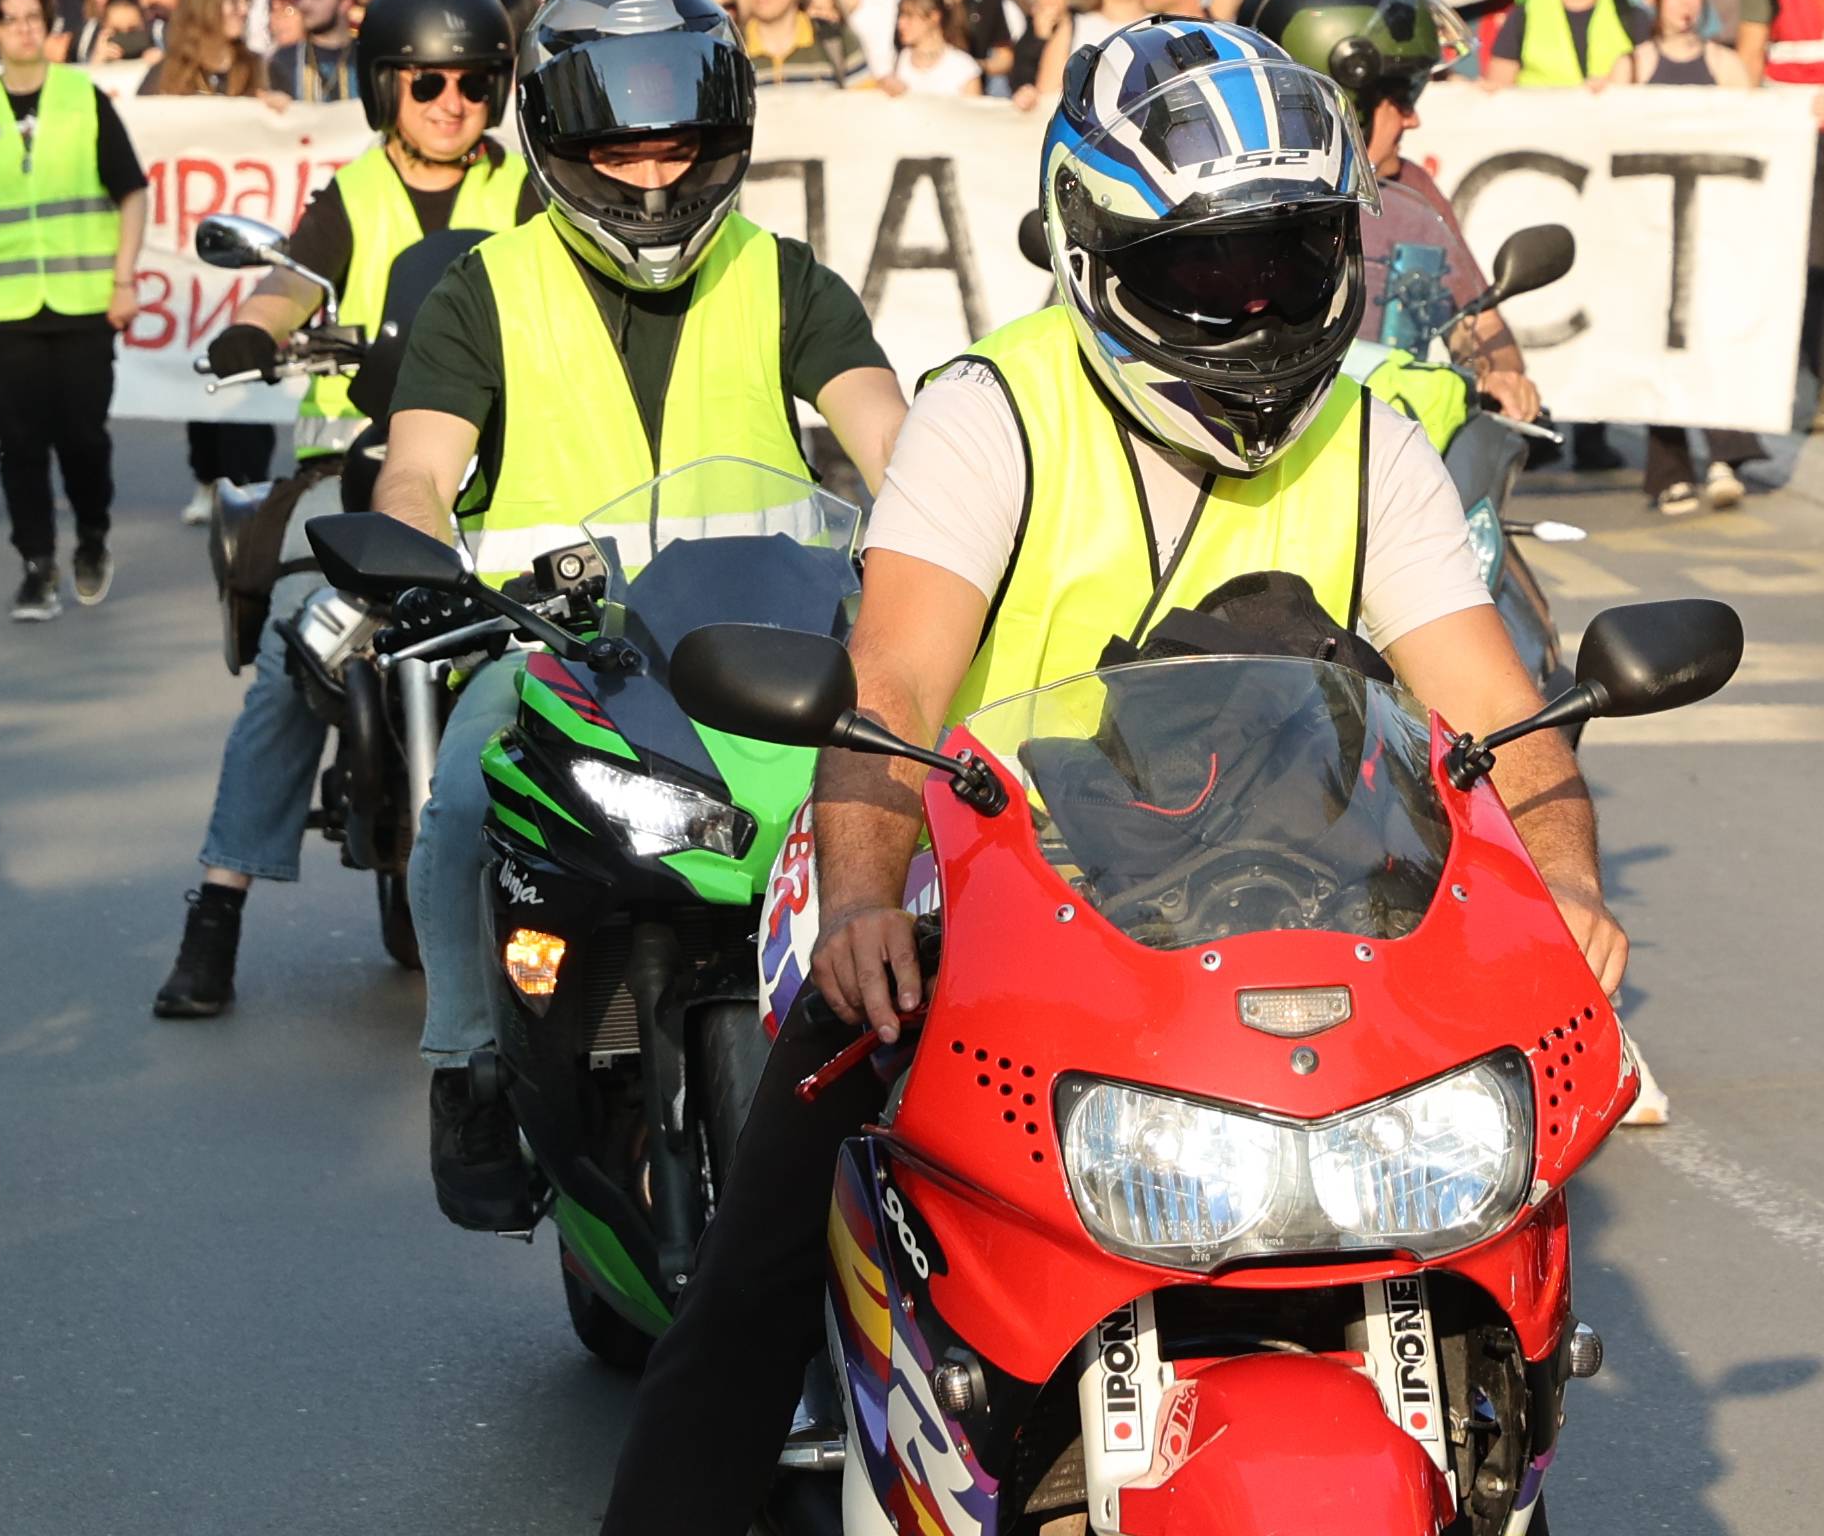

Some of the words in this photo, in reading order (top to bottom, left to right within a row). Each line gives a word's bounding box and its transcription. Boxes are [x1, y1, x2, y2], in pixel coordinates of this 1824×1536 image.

[1198, 150, 1310, 179] LS2
[499, 858, 545, 905] Ninja
[882, 1186, 930, 1281] 900
[1098, 1300, 1140, 1414] IPON
